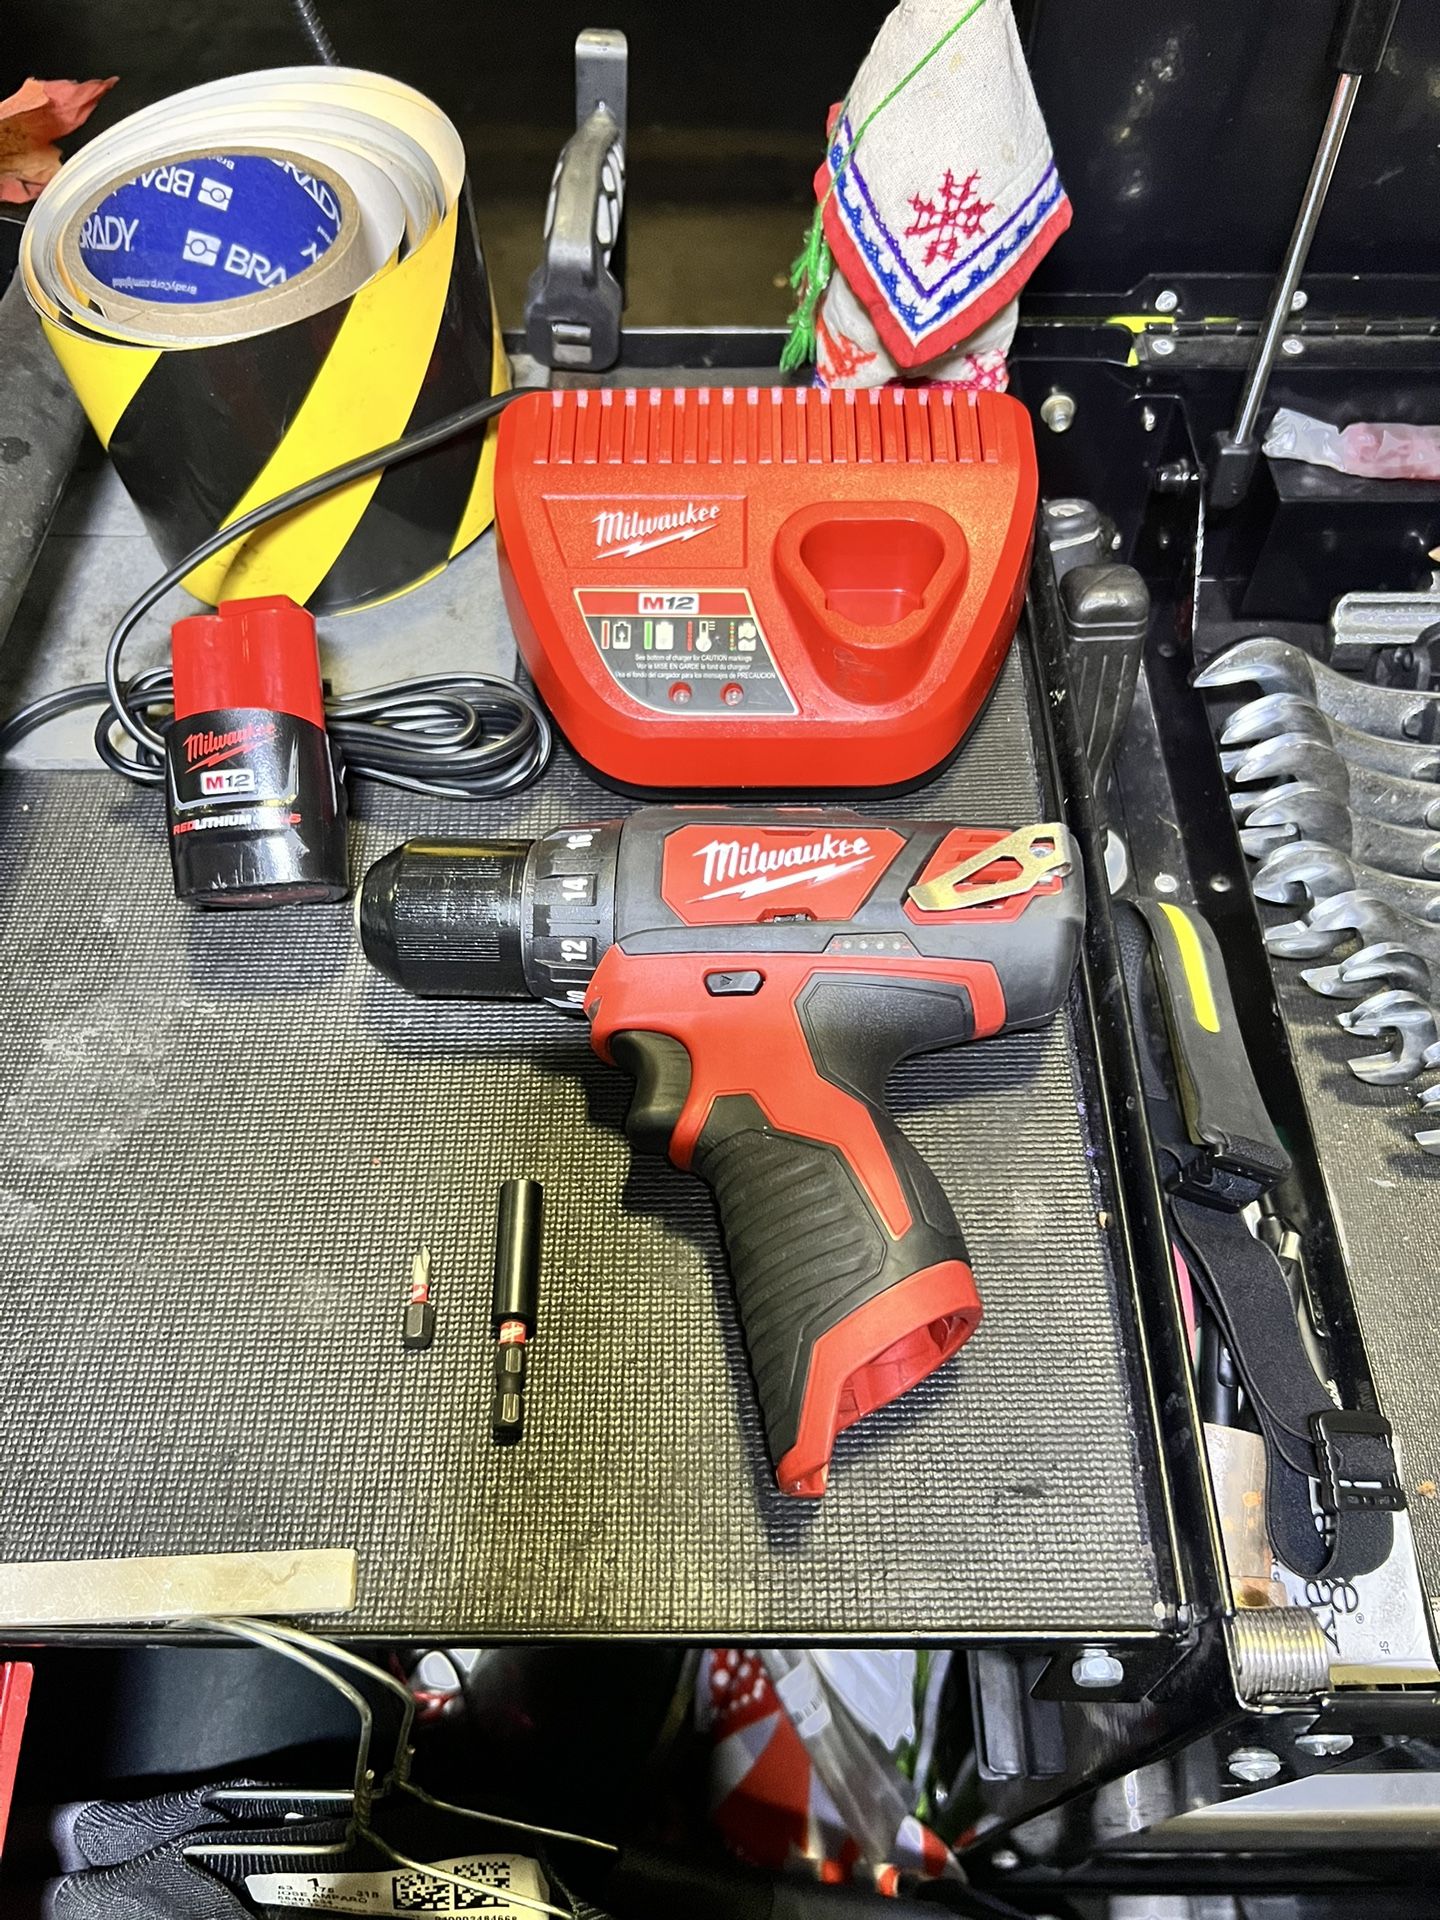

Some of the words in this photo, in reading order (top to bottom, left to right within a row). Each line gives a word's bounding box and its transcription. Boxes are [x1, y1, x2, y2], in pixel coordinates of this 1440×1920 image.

[592, 502, 720, 548] Milwaukee
[643, 596, 695, 610] M12
[654, 662, 668, 670] MISE
[672, 654, 692, 663] charger
[701, 654, 727, 662] CAUTION
[728, 655, 752, 663] markings
[657, 671, 681, 679] cargador
[681, 672, 694, 680] para
[183, 723, 278, 763] Milwaukee
[205, 774, 251, 790] M12
[566, 834, 593, 850] 16
[692, 833, 871, 886] Milwaukee
[562, 878, 588, 901] 14
[561, 940, 588, 962] 12
[1378, 1640, 1391, 1656] SF
